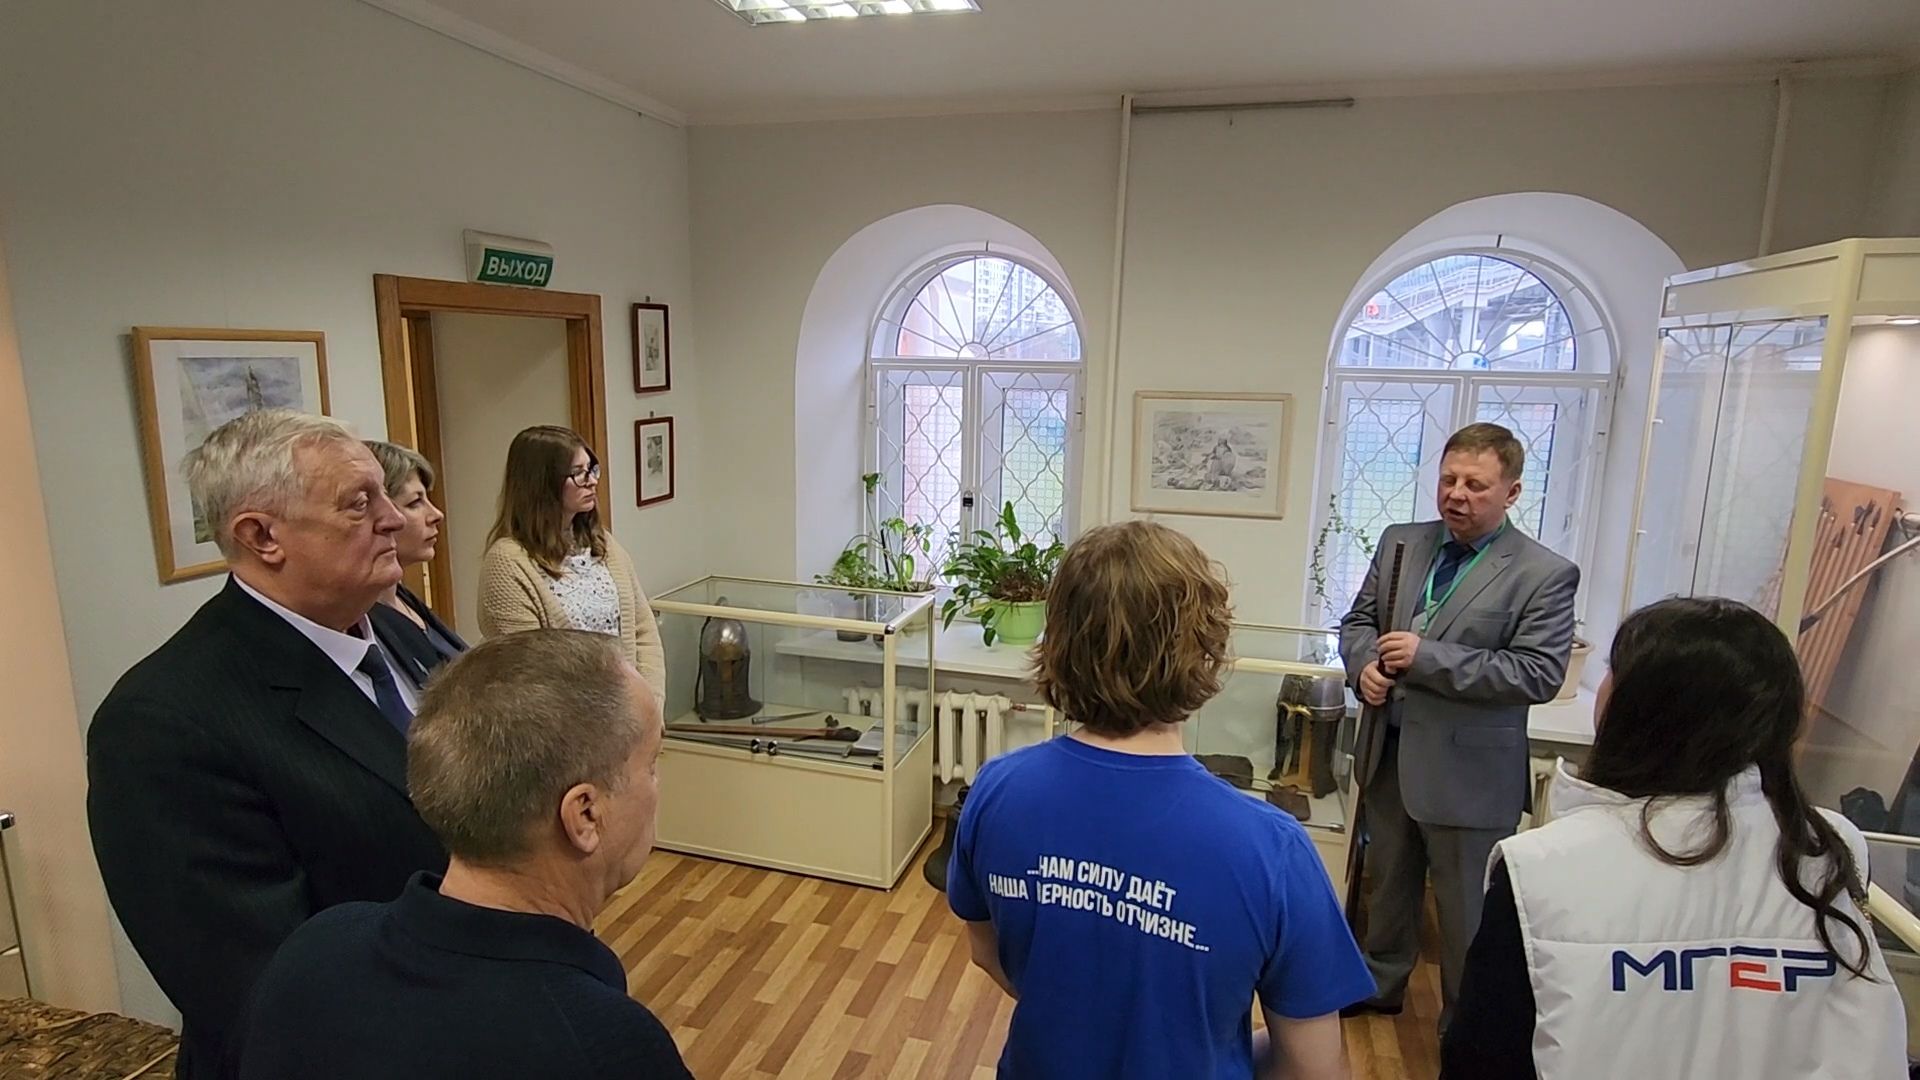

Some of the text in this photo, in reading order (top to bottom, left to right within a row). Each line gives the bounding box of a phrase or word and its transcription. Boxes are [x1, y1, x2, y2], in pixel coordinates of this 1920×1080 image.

[486, 256, 547, 284] ВЫХОД
[989, 872, 1029, 900] НАША
[1036, 880, 1113, 917] ЕРНОСТЬ
[1077, 861, 1125, 892] СИЛУ
[1125, 875, 1177, 912] ДАЁТ
[1611, 945, 1837, 992] МГЕР
